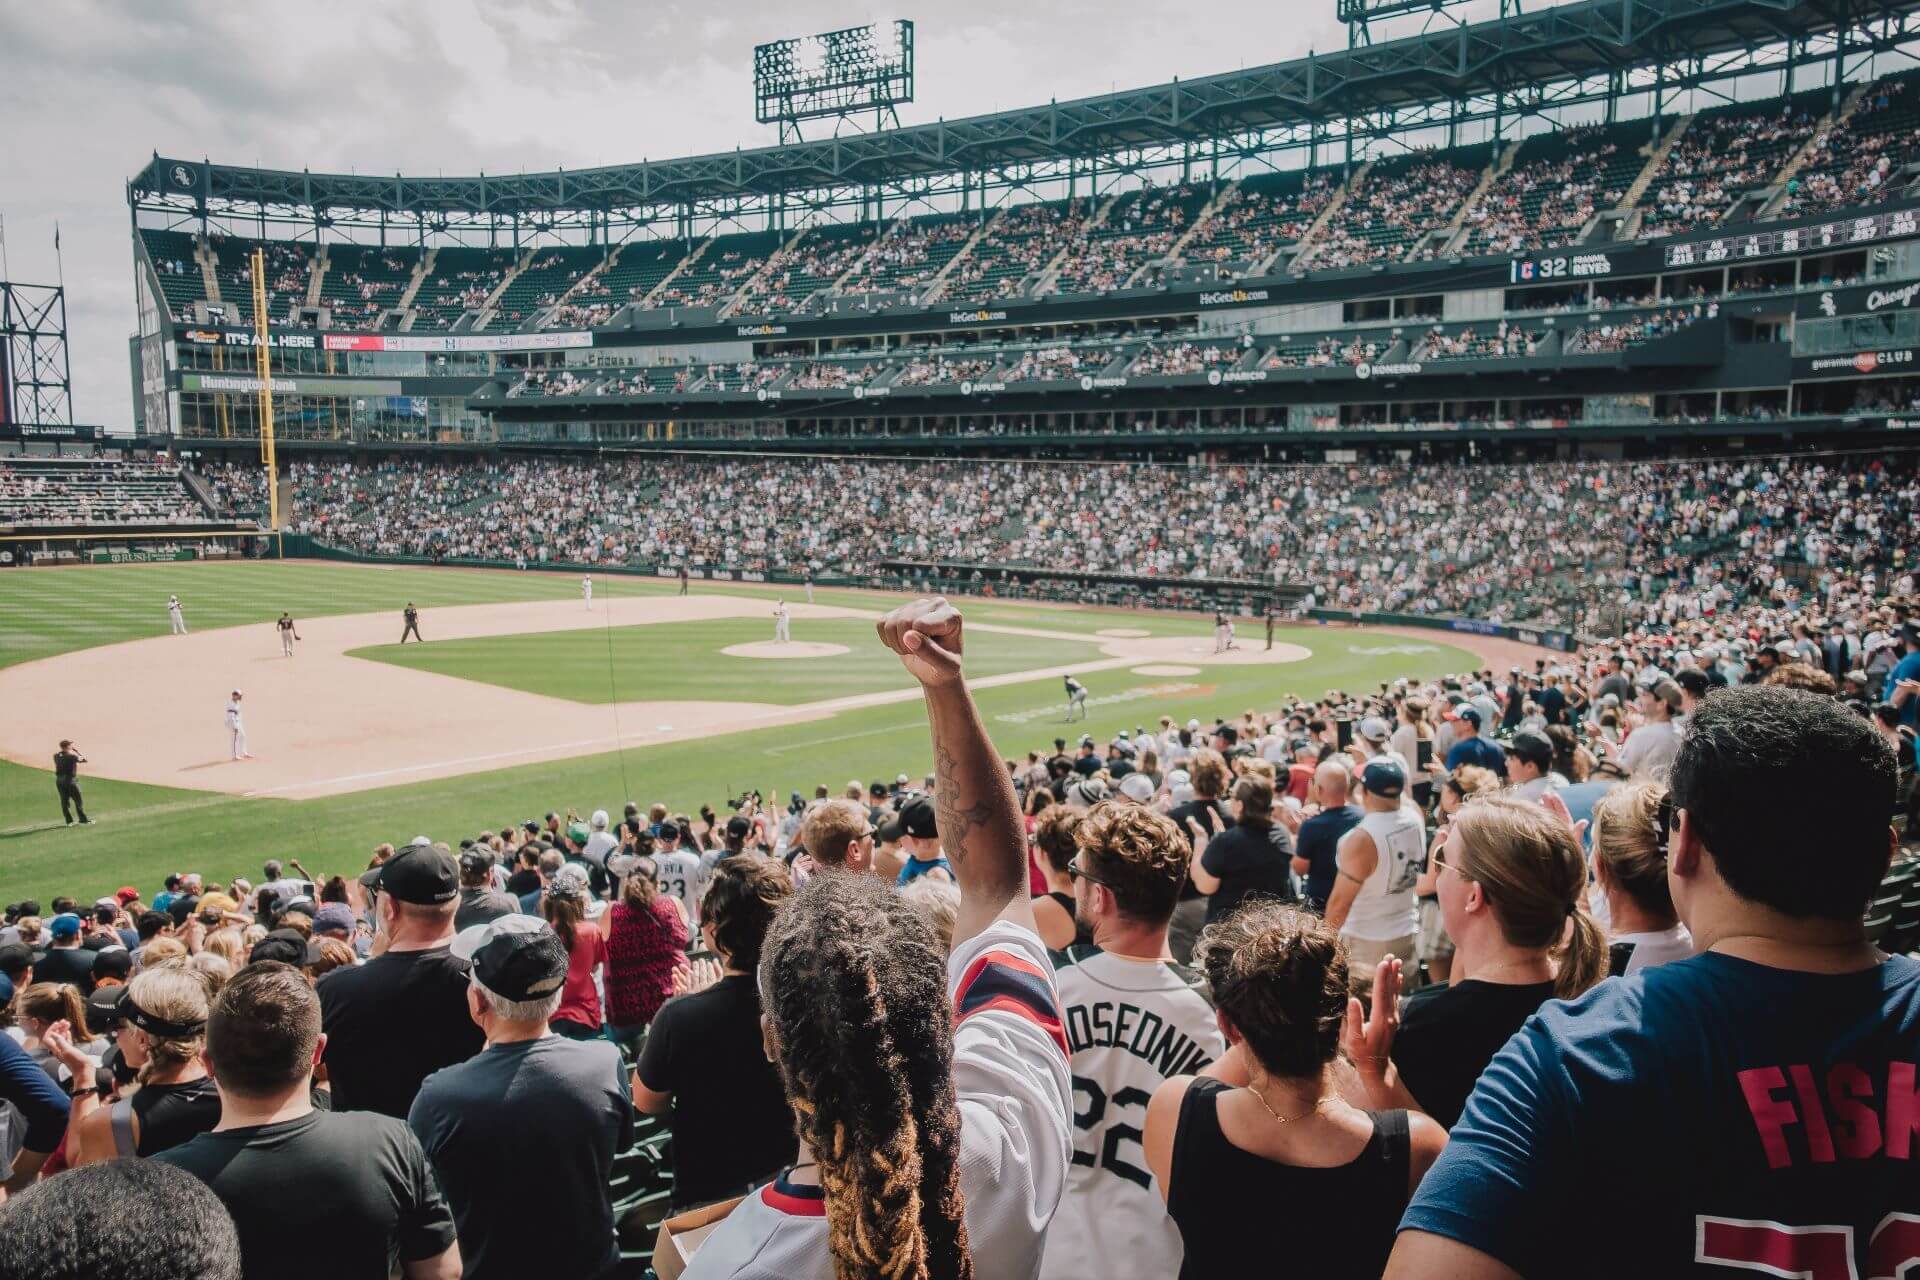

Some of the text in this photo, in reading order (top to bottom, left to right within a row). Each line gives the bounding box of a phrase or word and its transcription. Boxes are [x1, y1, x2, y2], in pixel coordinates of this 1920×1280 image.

[1540, 257, 1567, 278] 32
[1573, 262, 1611, 276] REYES
[1199, 290, 1269, 305] HeGetsUs.com
[950, 310, 1007, 323] HeGetsUs.com
[737, 325, 787, 336] HeGetsUs.com
[225, 333, 249, 345] IT'S
[251, 335, 278, 347] AL
[280, 336, 315, 348] HERE
[1876, 350, 1913, 364] CLUB
[1065, 1001, 1213, 1080] DSEDNIK
